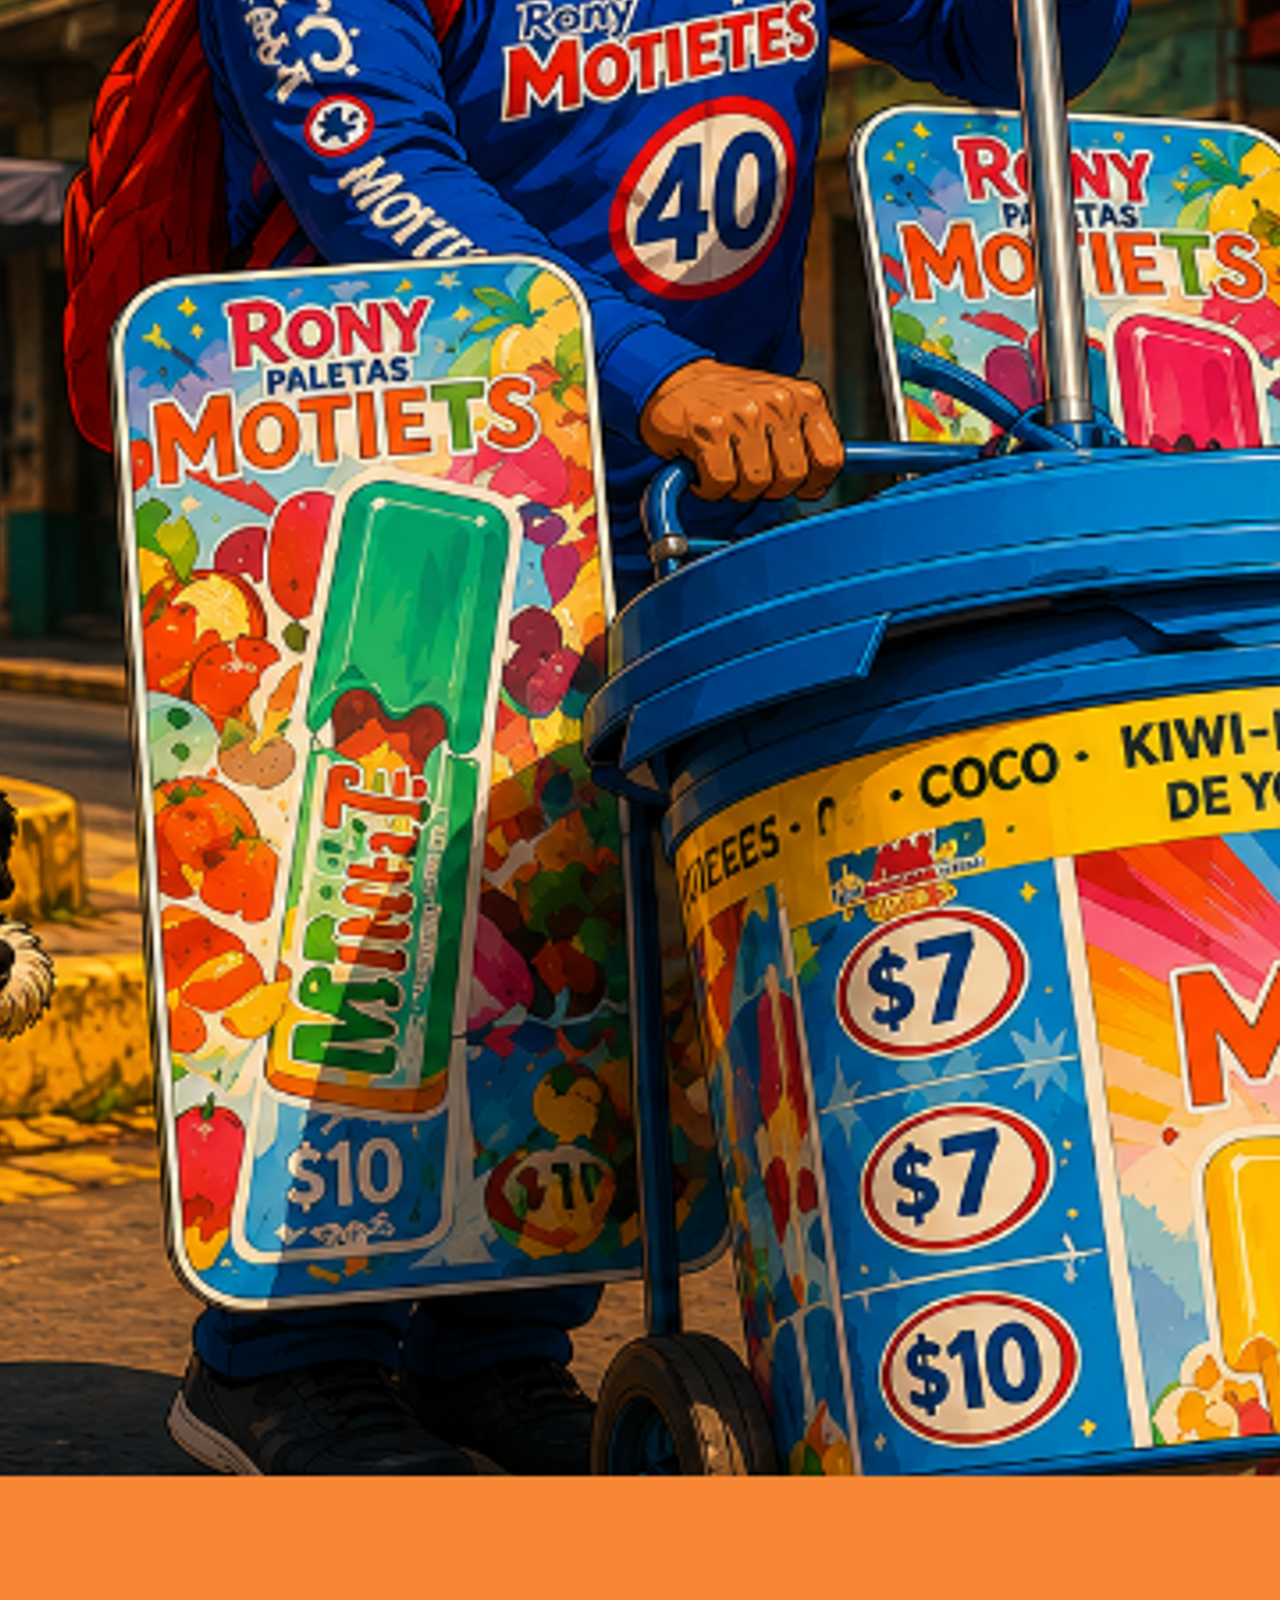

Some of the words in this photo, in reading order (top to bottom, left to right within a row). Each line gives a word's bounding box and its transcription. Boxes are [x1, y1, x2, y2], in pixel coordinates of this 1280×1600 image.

[634, 131, 780, 264] 40
[953, 137, 1153, 203] RNY
[898, 220, 1268, 302] MOIETS
[225, 297, 432, 370] RONY
[265, 356, 412, 396] PALETAS
[150, 376, 542, 488] MOTIETS
[919, 743, 1060, 807] COCO
[1167, 778, 1232, 822] DE
[866, 930, 978, 1034] $7
[286, 1138, 404, 1212] $10
[890, 1128, 1002, 1224] $7
[906, 1322, 1044, 1414] $10
